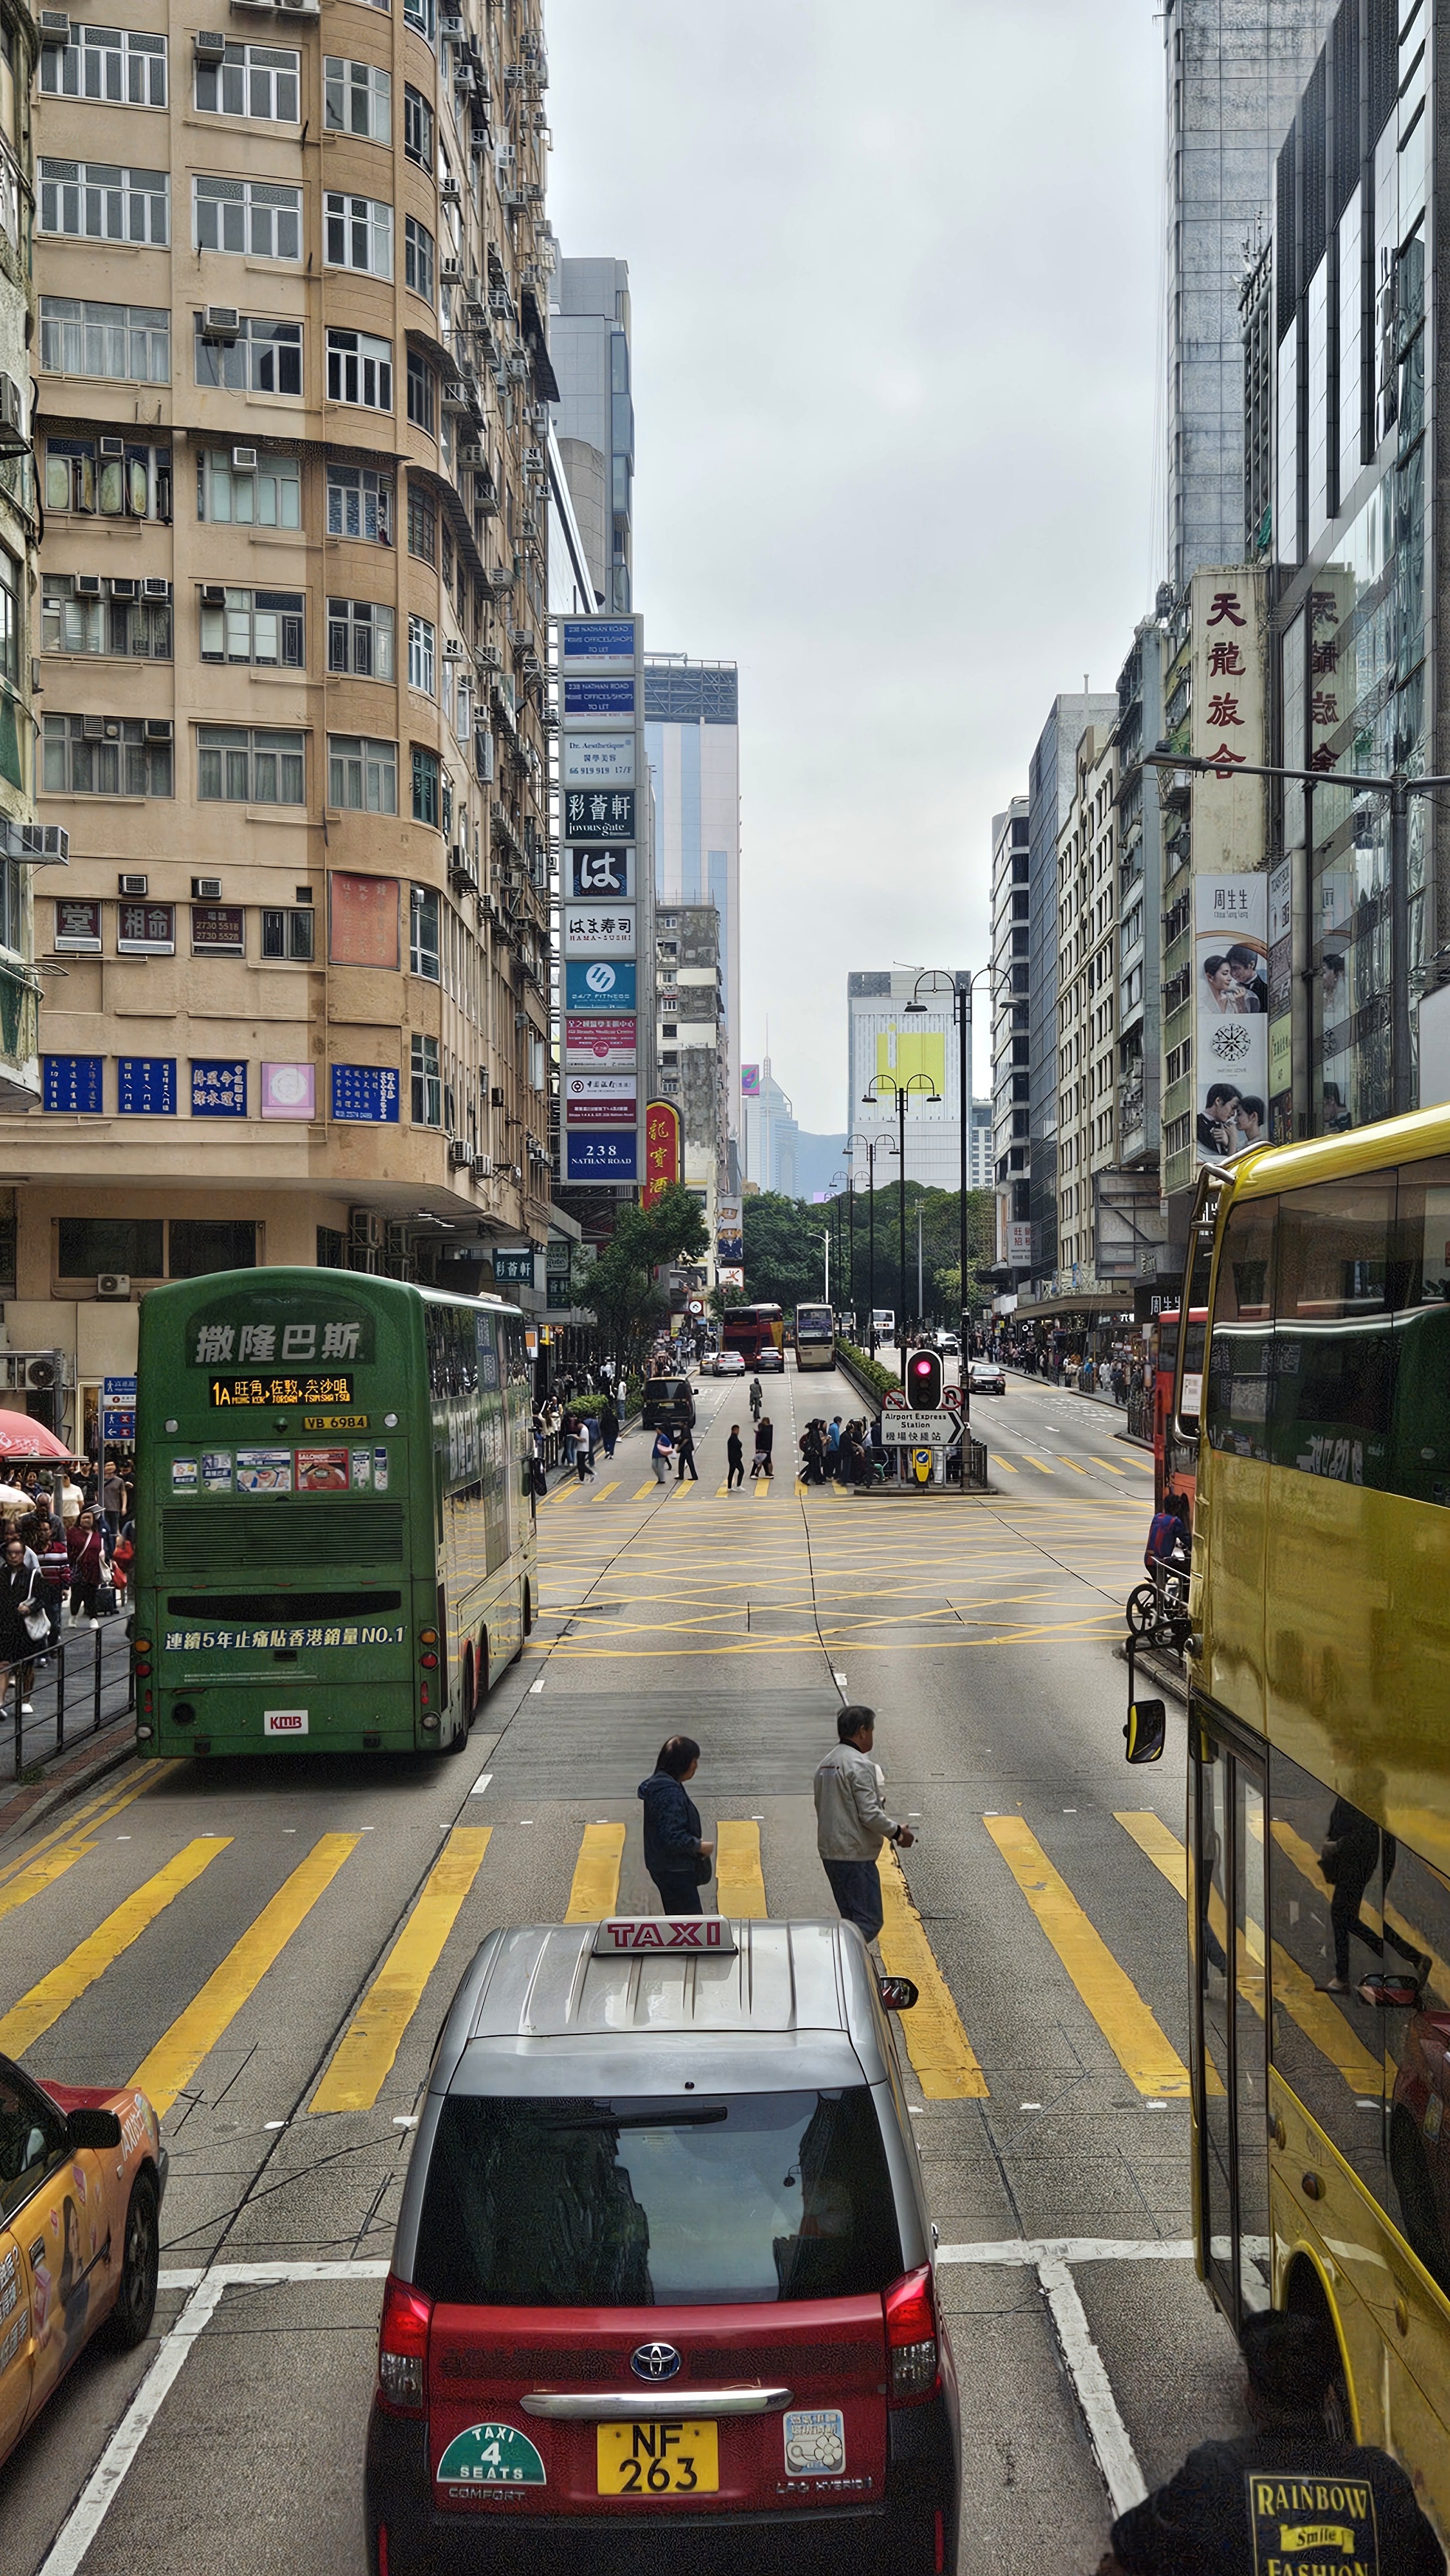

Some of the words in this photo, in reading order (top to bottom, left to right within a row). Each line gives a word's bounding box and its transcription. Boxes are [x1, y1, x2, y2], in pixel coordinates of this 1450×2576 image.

[569, 794, 631, 821] 彩薈軒
[581, 851, 620, 889] は
[1214, 889, 1248, 910] 周生生
[570, 918, 631, 934] はま寿司
[586, 1145, 617, 1156] 238
[195, 1322, 361, 1363] 撒隆巴斯
[213, 1381, 231, 1405] 1A
[234, 1379, 263, 1396] 旺角
[270, 1379, 298, 1395] 佐敦
[305, 1378, 348, 1394] 尖沙咀
[307, 1417, 325, 1428] VB
[330, 1416, 364, 1428] 6984
[270, 1716, 303, 1730] KMB
[607, 1922, 720, 1947] TAXI
[471, 2426, 514, 2443] TAXI
[632, 2423, 683, 2458] NF
[480, 2440, 502, 2466] 4
[460, 2465, 523, 2480] SEATS
[619, 2458, 698, 2493] 263
[449, 2486, 527, 2501] COMFORT
[1256, 2483, 1368, 2520] RAINBOW
